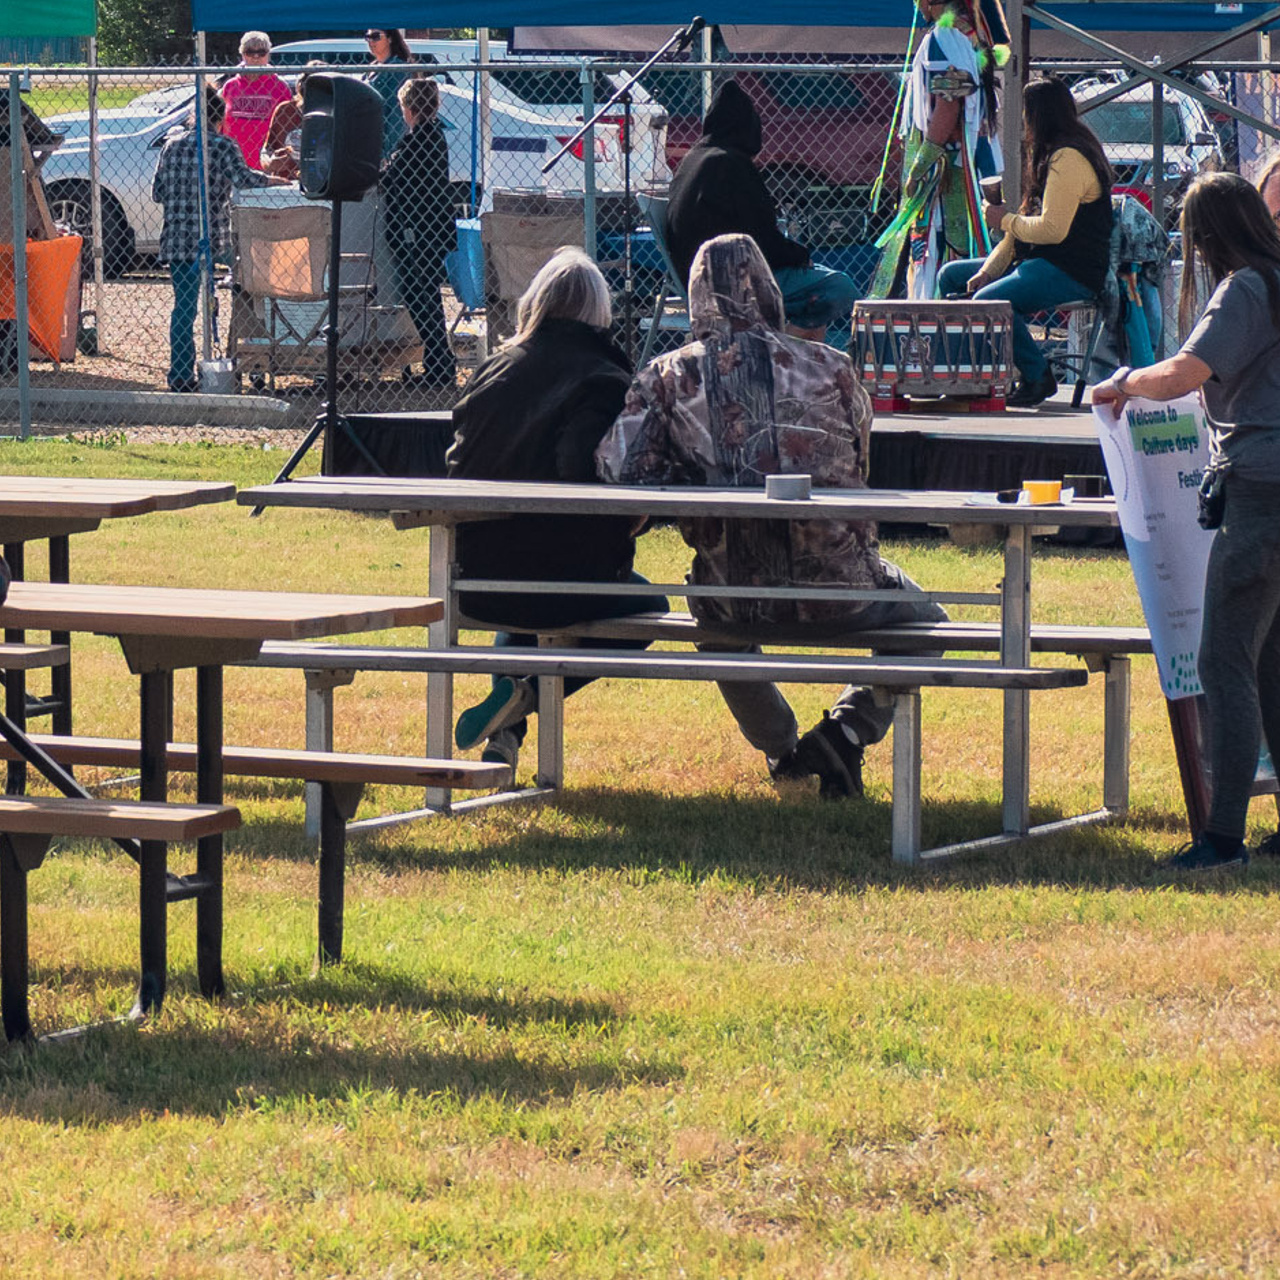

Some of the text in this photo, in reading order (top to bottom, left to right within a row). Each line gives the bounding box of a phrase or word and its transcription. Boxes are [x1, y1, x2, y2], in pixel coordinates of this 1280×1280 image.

[1125, 405, 1178, 427] Welcome to
[1142, 434, 1199, 456] Culture days
